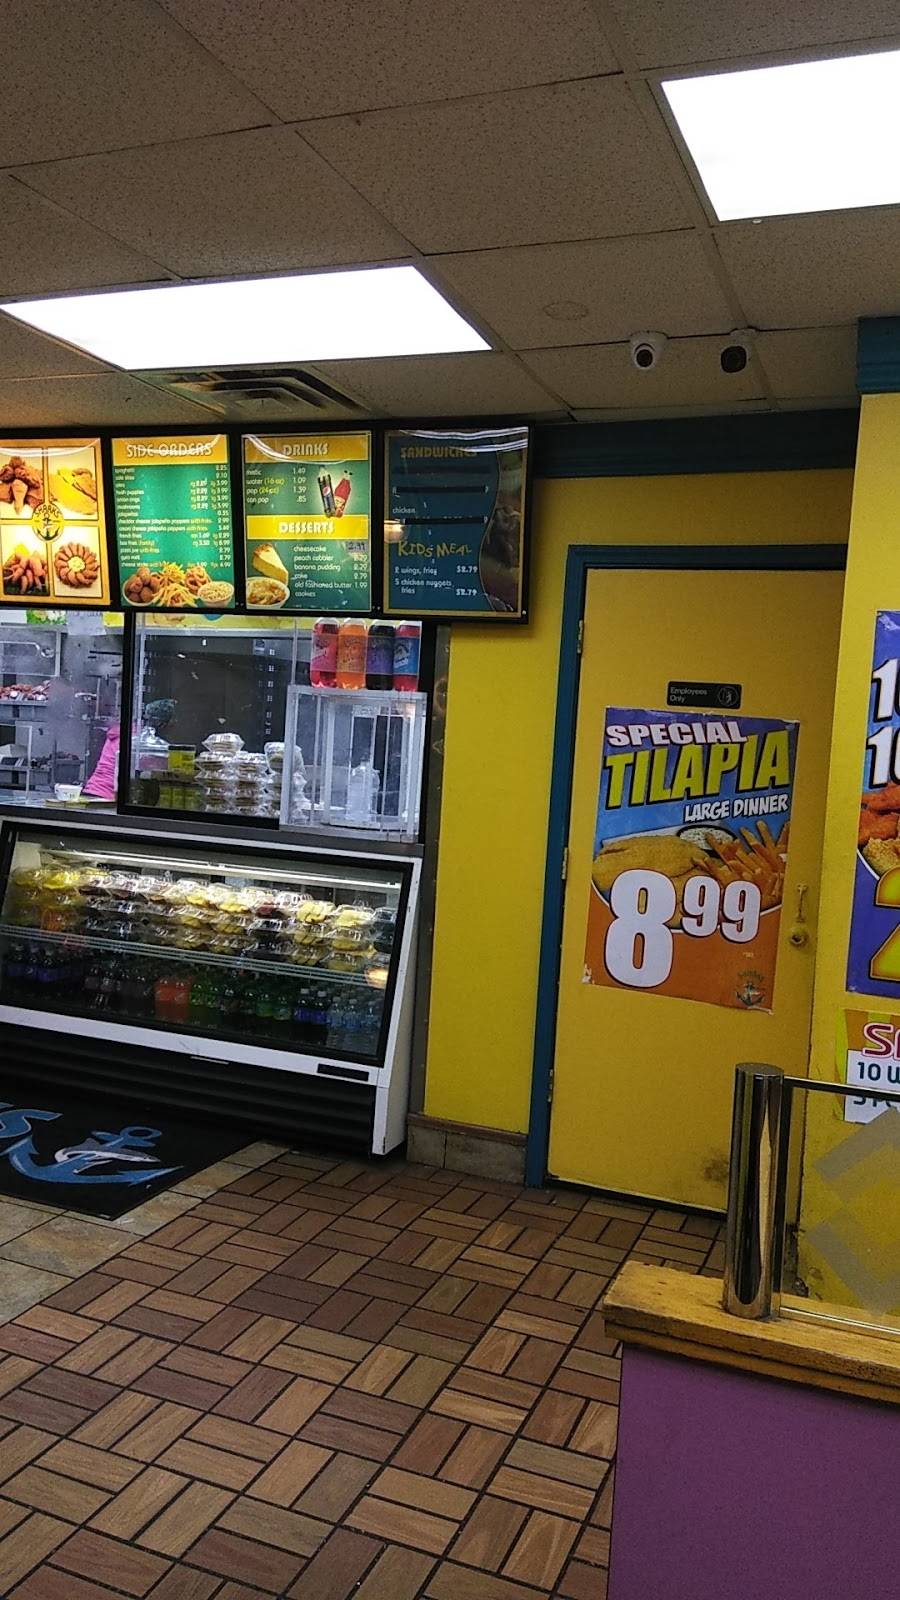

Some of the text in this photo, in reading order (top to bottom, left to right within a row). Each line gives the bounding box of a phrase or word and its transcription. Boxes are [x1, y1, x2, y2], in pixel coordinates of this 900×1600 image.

[126, 443, 213, 458] SIDE ORDERS
[283, 443, 328, 456] DRINKS
[392, 506, 416, 514] chicken
[279, 521, 334, 534] DESSERTS
[293, 543, 327, 552] cheesecake
[436, 542, 472, 558] MEAL
[317, 563, 341, 572] pudding
[401, 578, 424, 586] chicken
[670, 686, 708, 696] Employees
[669, 694, 685, 703] Only
[606, 721, 748, 746] SPECIAL
[605, 730, 791, 809] TILAPIA
[684, 794, 789, 823] LARGE DINNER
[858, 1061, 881, 1081] 10
